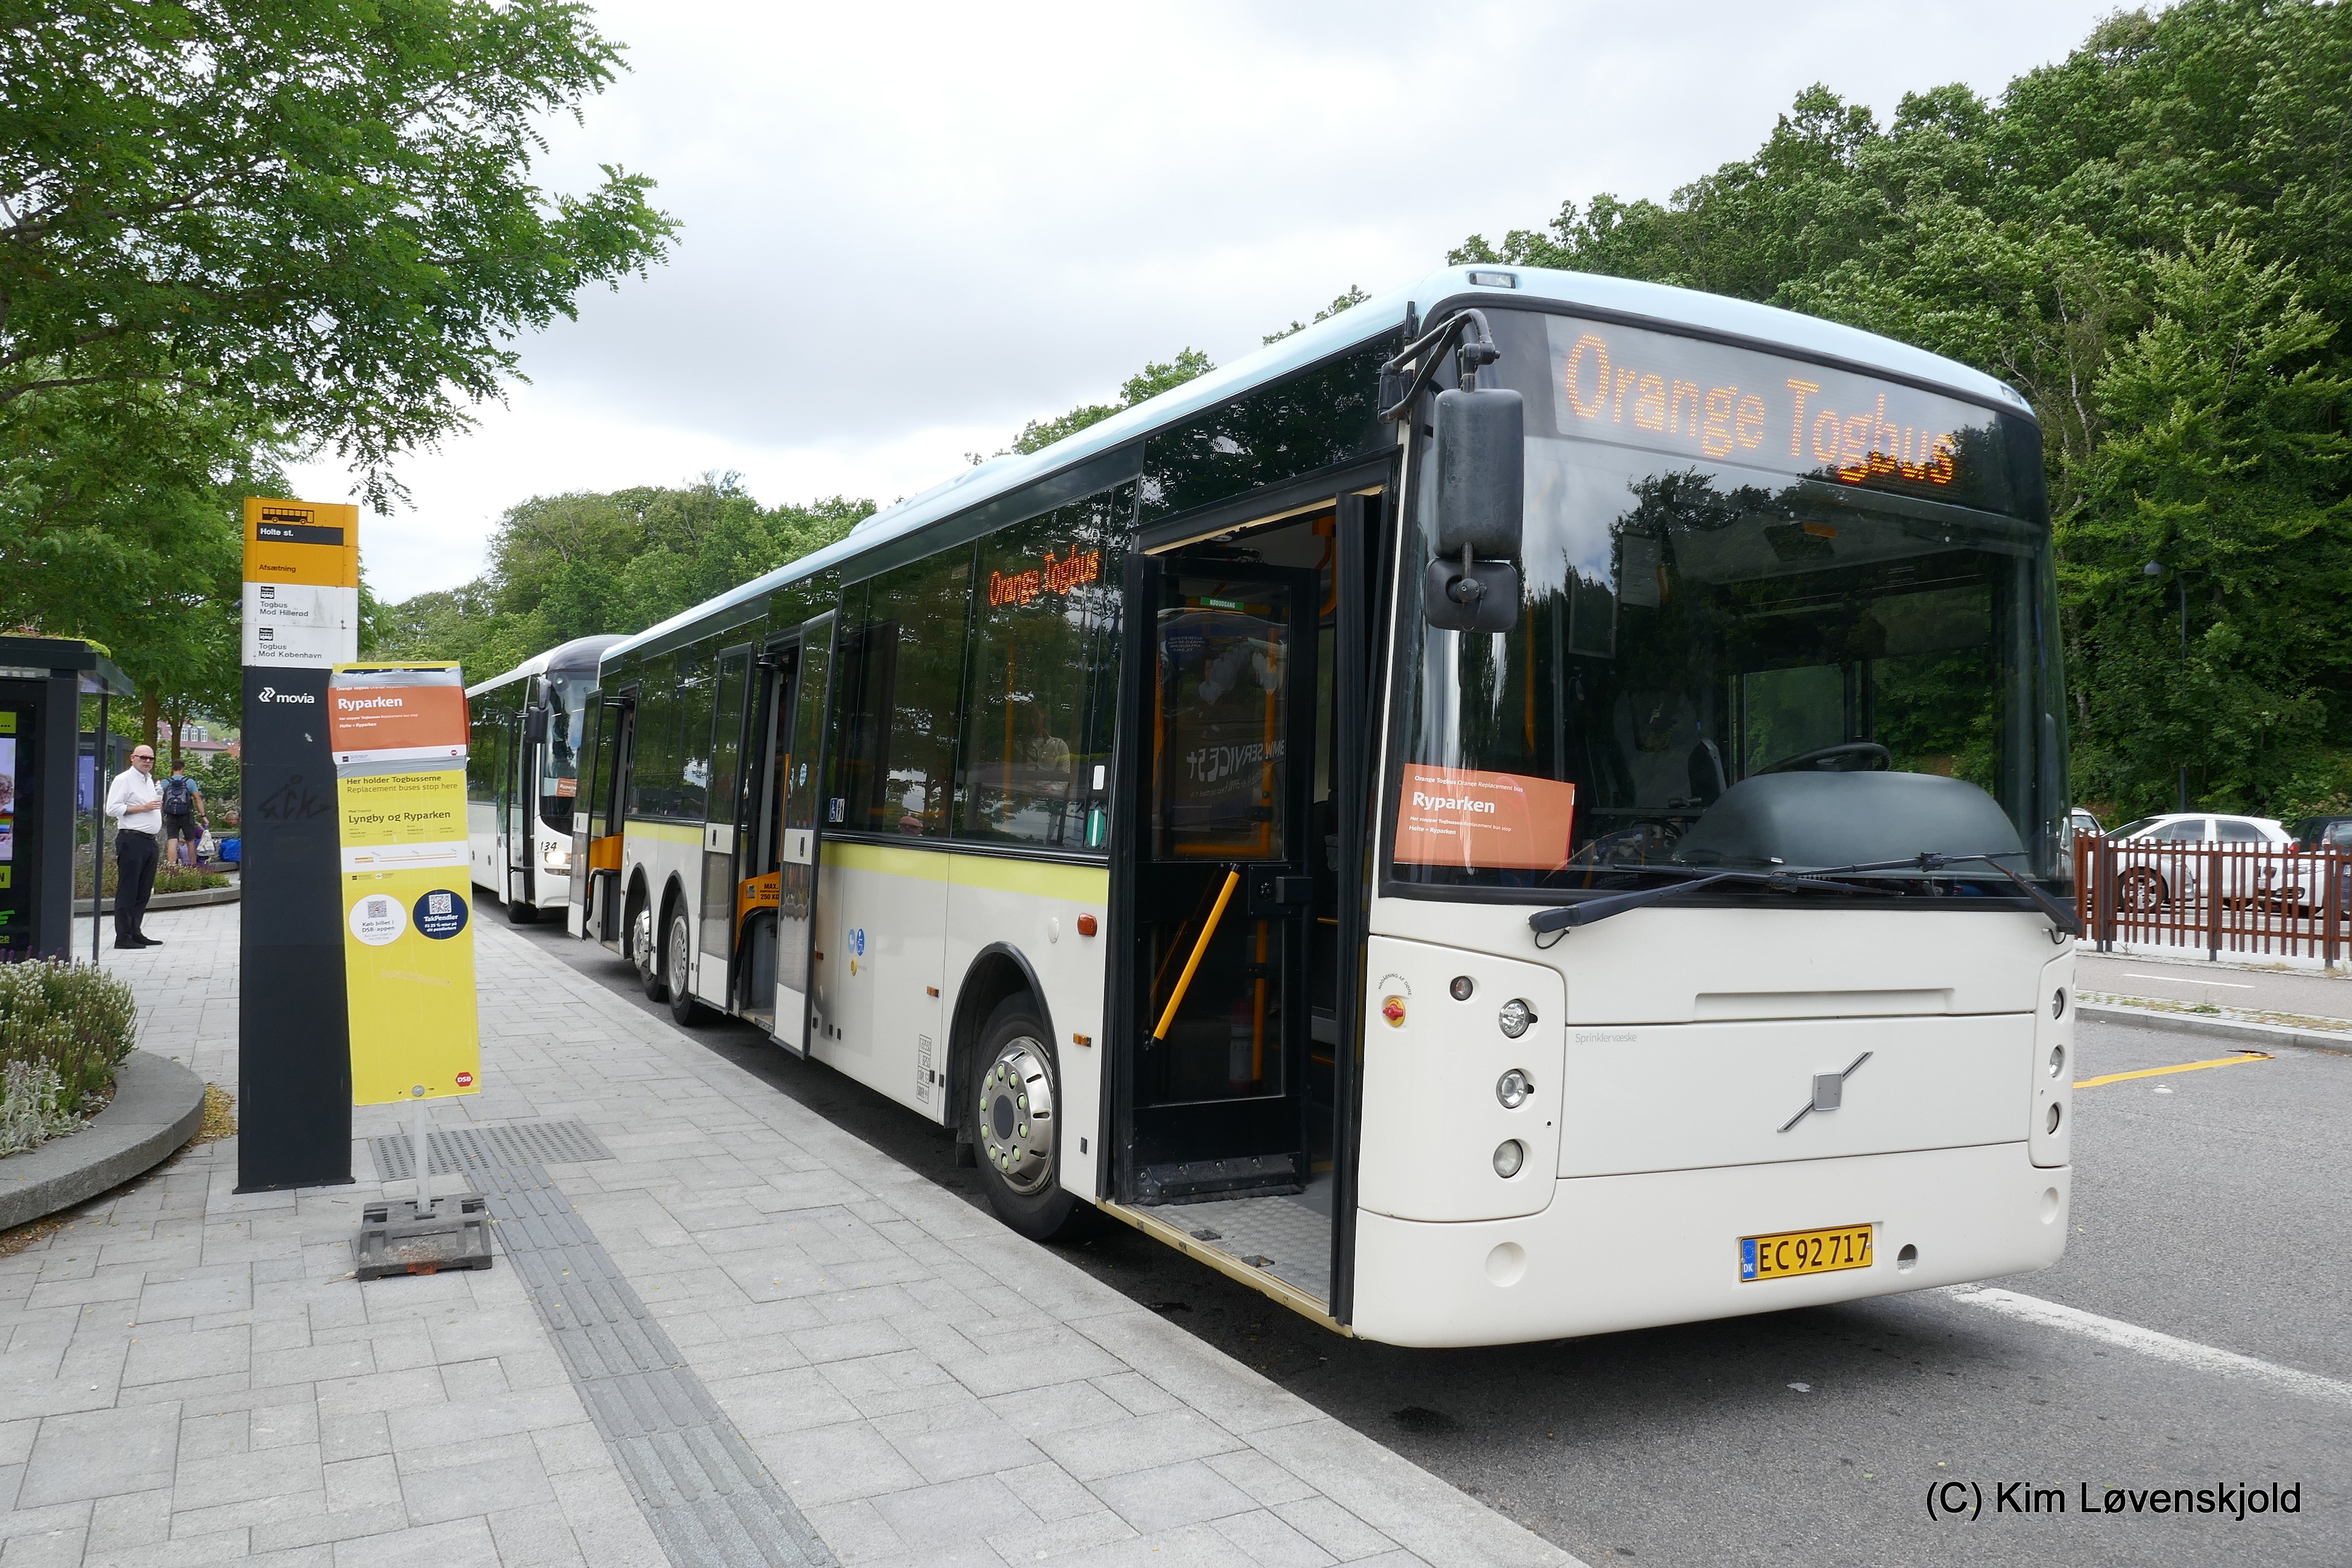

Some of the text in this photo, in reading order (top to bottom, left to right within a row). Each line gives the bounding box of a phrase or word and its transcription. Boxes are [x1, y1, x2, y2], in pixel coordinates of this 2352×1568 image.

[1566, 334, 1954, 484] Orange Togbus
[260, 527, 281, 536] Holte
[258, 564, 296, 573] Afsætning
[989, 544, 1099, 606] Orange Togbus
[1209, 599, 1235, 609] NØDUDGANG
[276, 693, 315, 704] movia
[337, 696, 403, 711] Ryparken
[347, 785, 396, 795] Replacement
[1478, 782, 1513, 791] Replacement
[1412, 791, 1496, 814] Ryparken
[349, 810, 451, 825] Lyngby og Ryparken
[1463, 821, 1492, 829] Replacement
[1430, 827, 1457, 835] Ryparken
[540, 842, 557, 851] 134
[1743, 1263, 1754, 1273] DK
